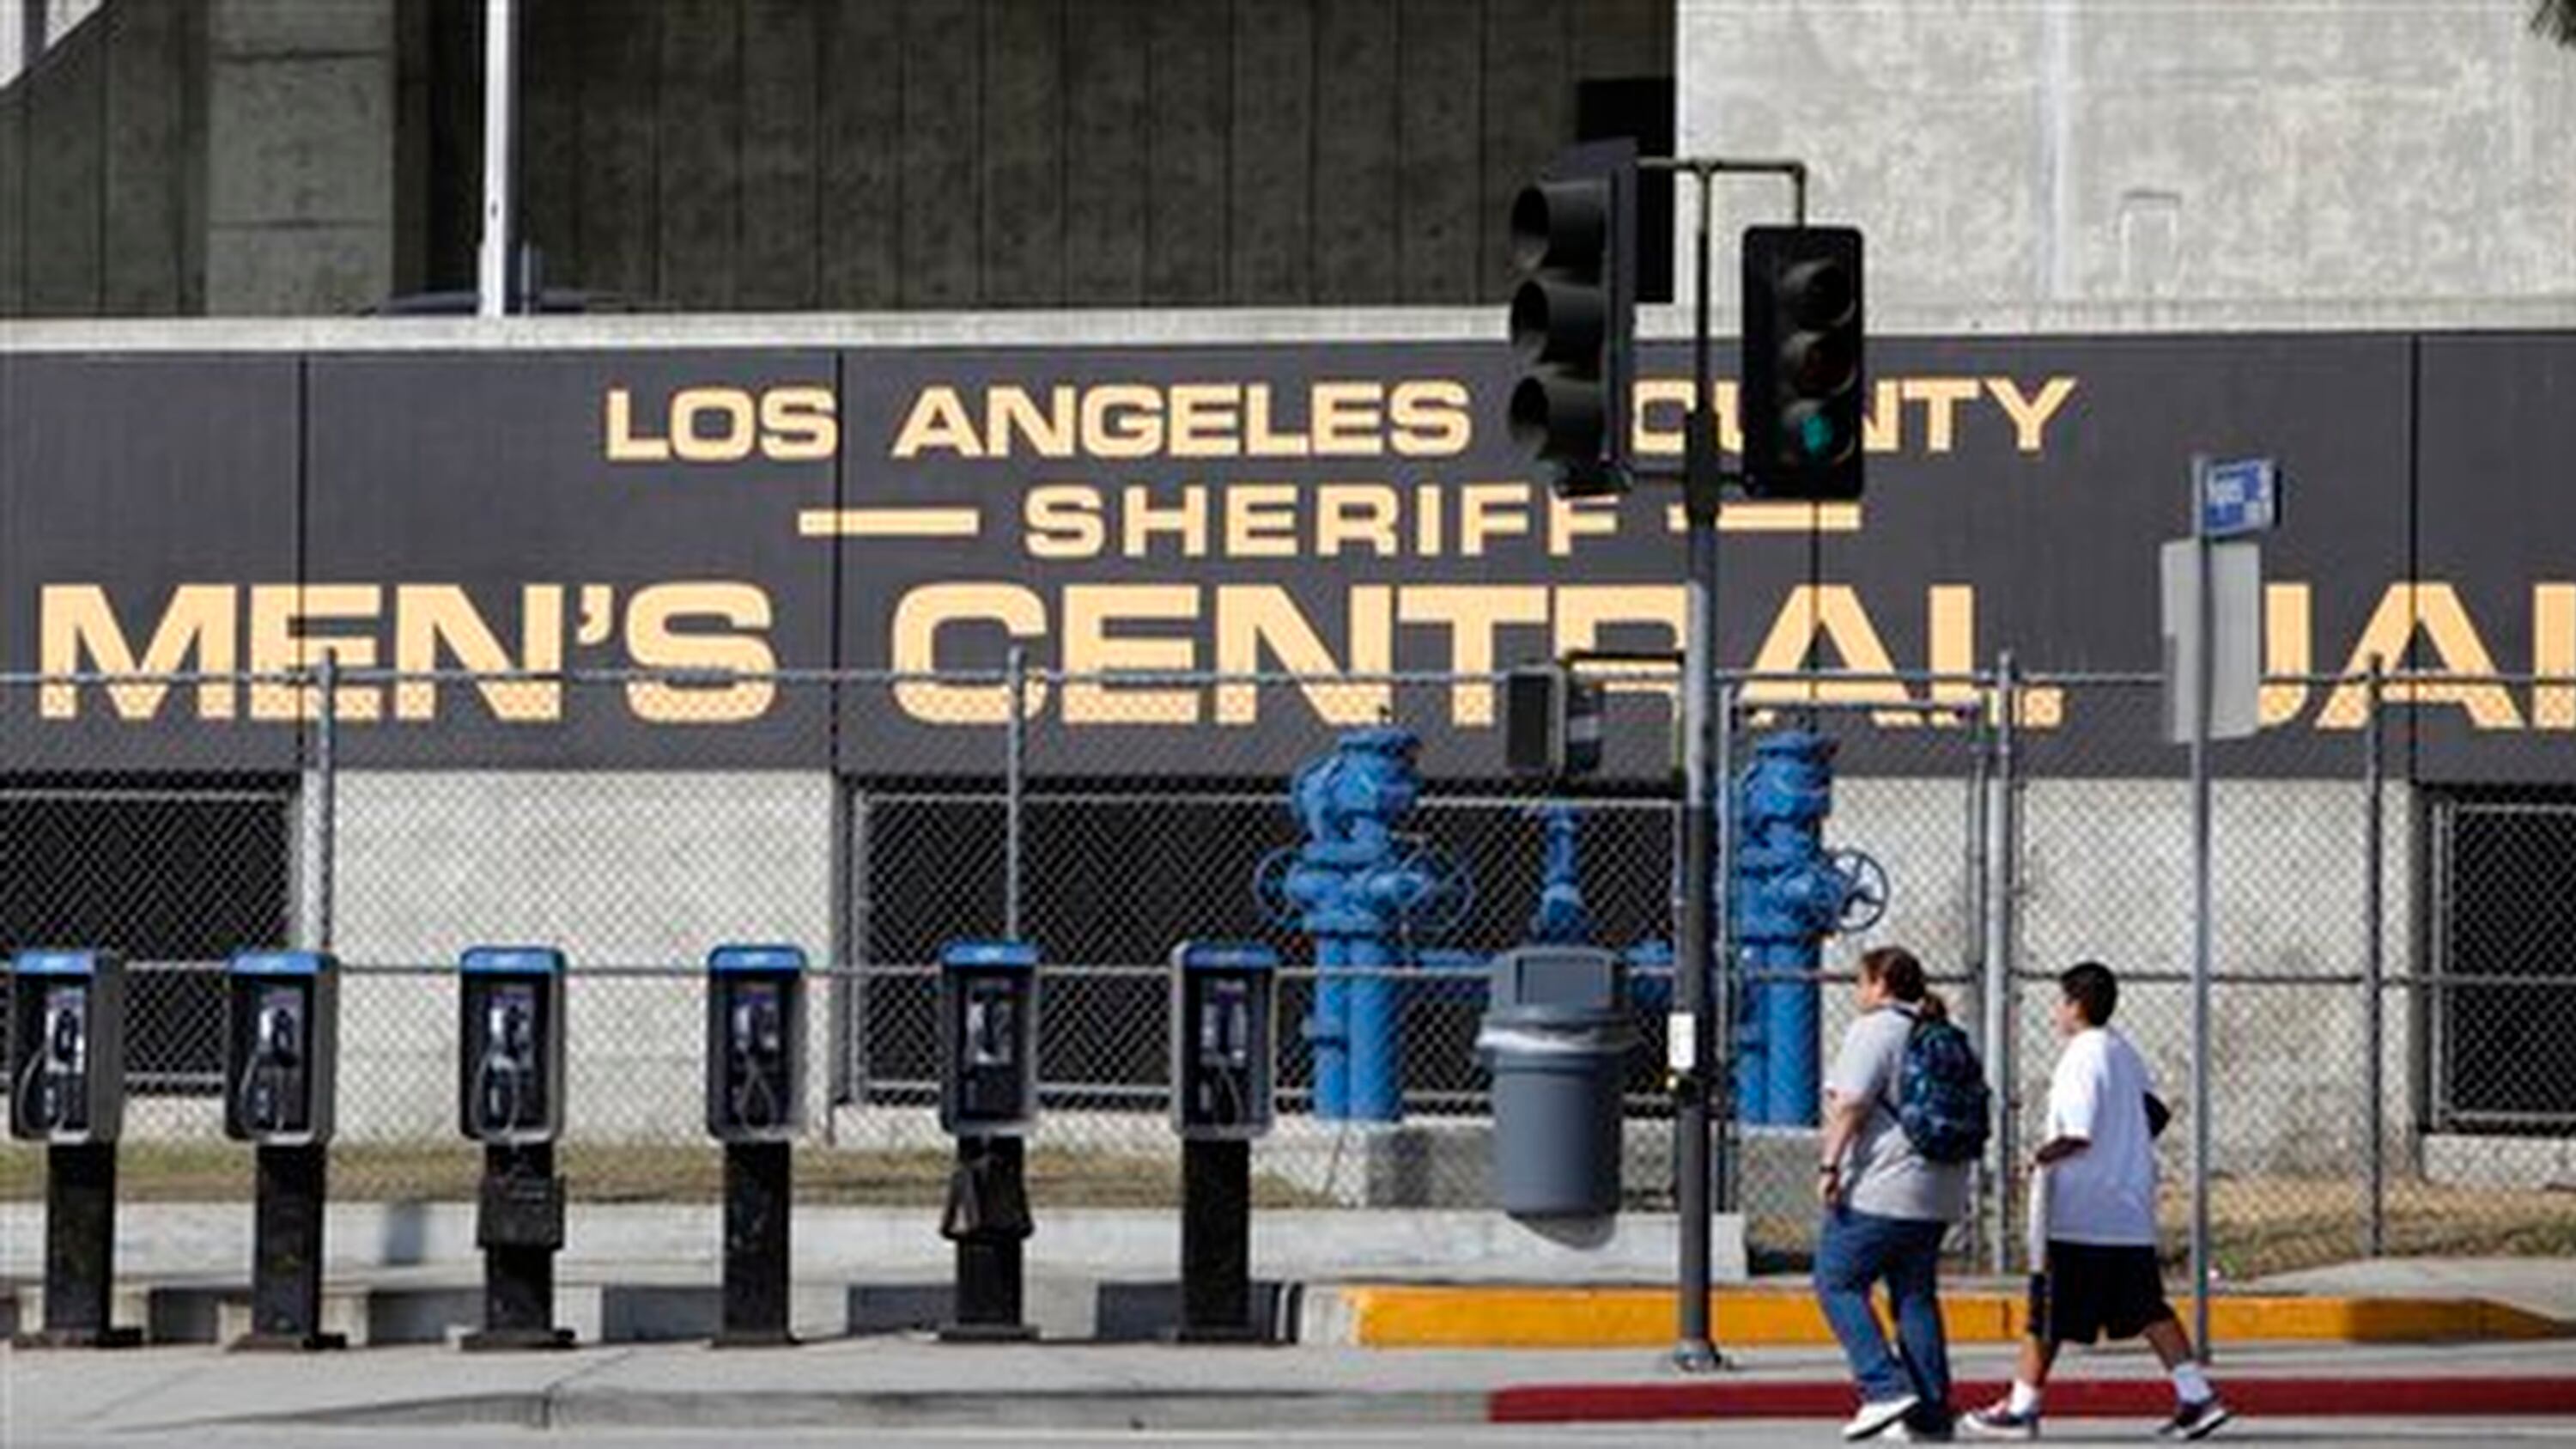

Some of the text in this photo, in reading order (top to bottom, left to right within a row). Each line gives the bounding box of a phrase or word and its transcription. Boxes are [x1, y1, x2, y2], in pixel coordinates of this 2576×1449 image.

[607, 379, 2075, 460] LOS ANGELES OTY
[1024, 484, 1619, 557] SHERIFF
[39, 583, 775, 722] MEN'S
[893, 584, 2063, 727] CENTRAL
